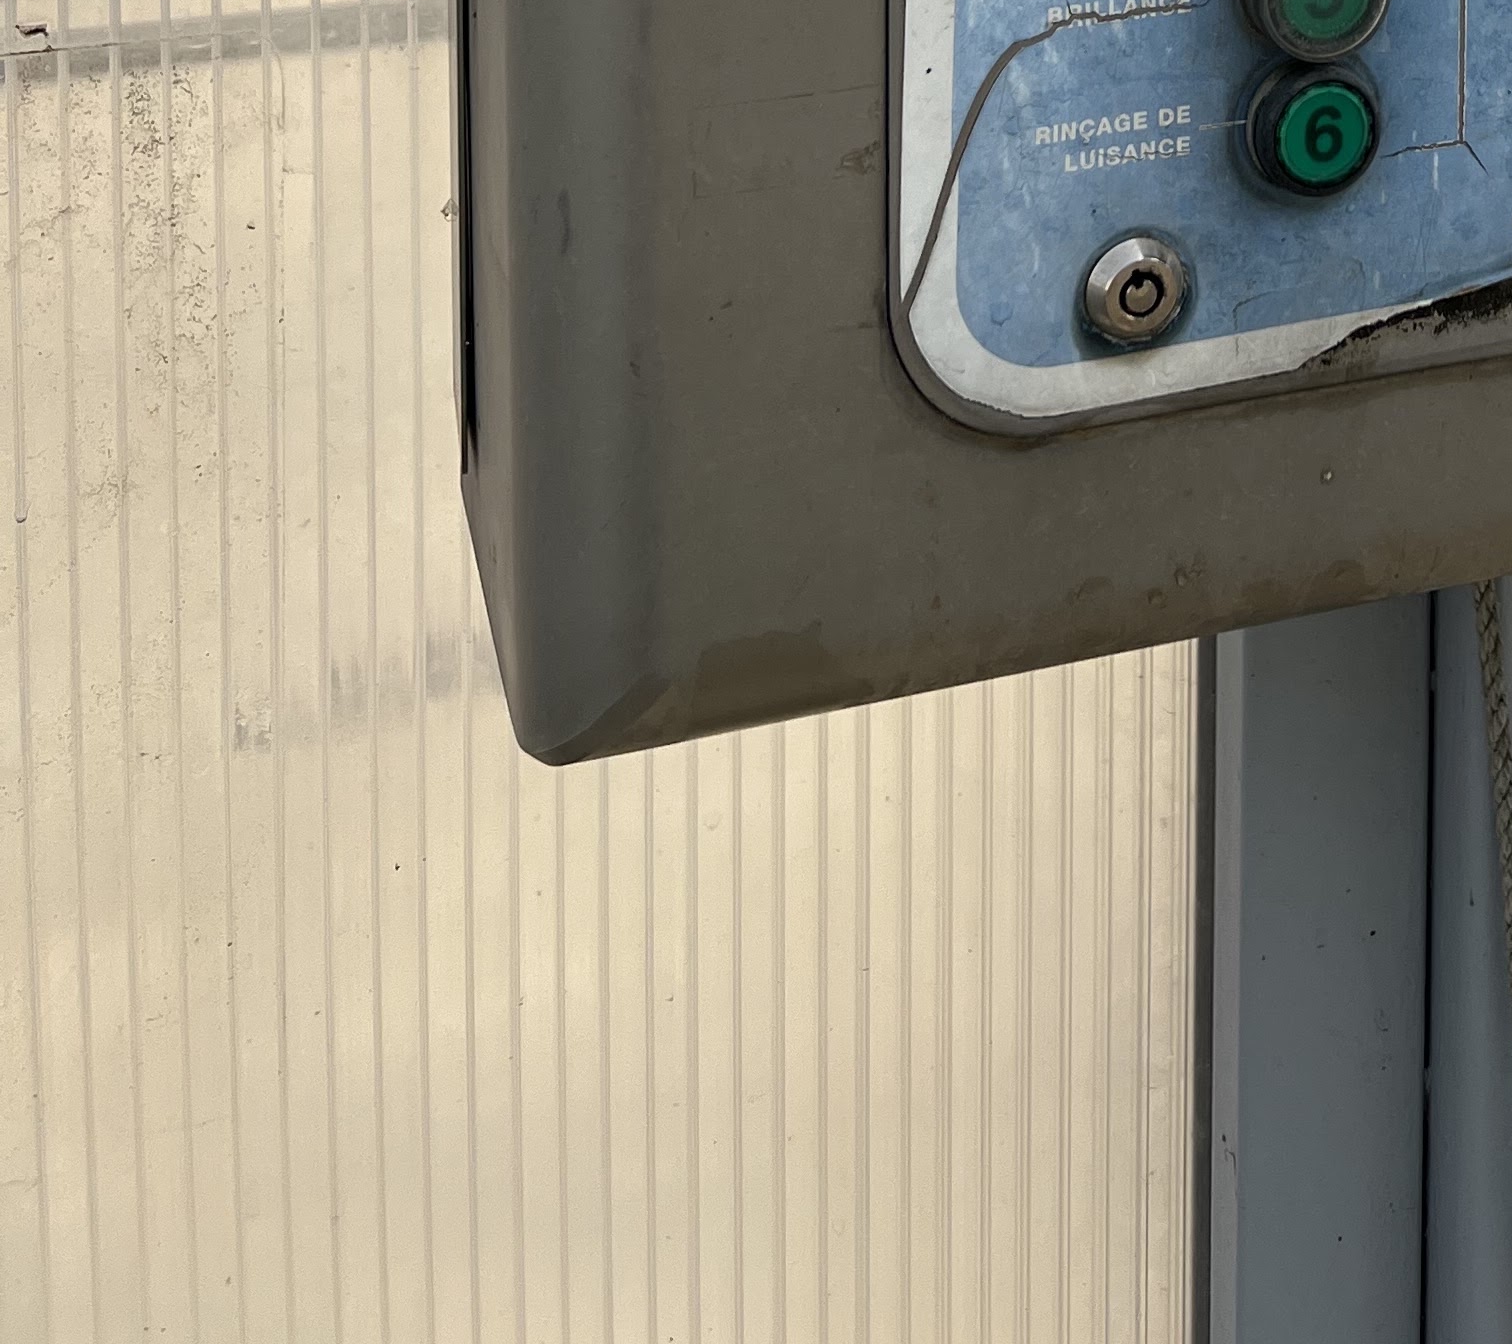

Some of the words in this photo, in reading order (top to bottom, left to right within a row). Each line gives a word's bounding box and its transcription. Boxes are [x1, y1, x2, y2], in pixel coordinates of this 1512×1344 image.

[1035, 110, 1148, 145] RINÇAGE
[1158, 105, 1191, 127] DE
[1304, 104, 1344, 163] 6
